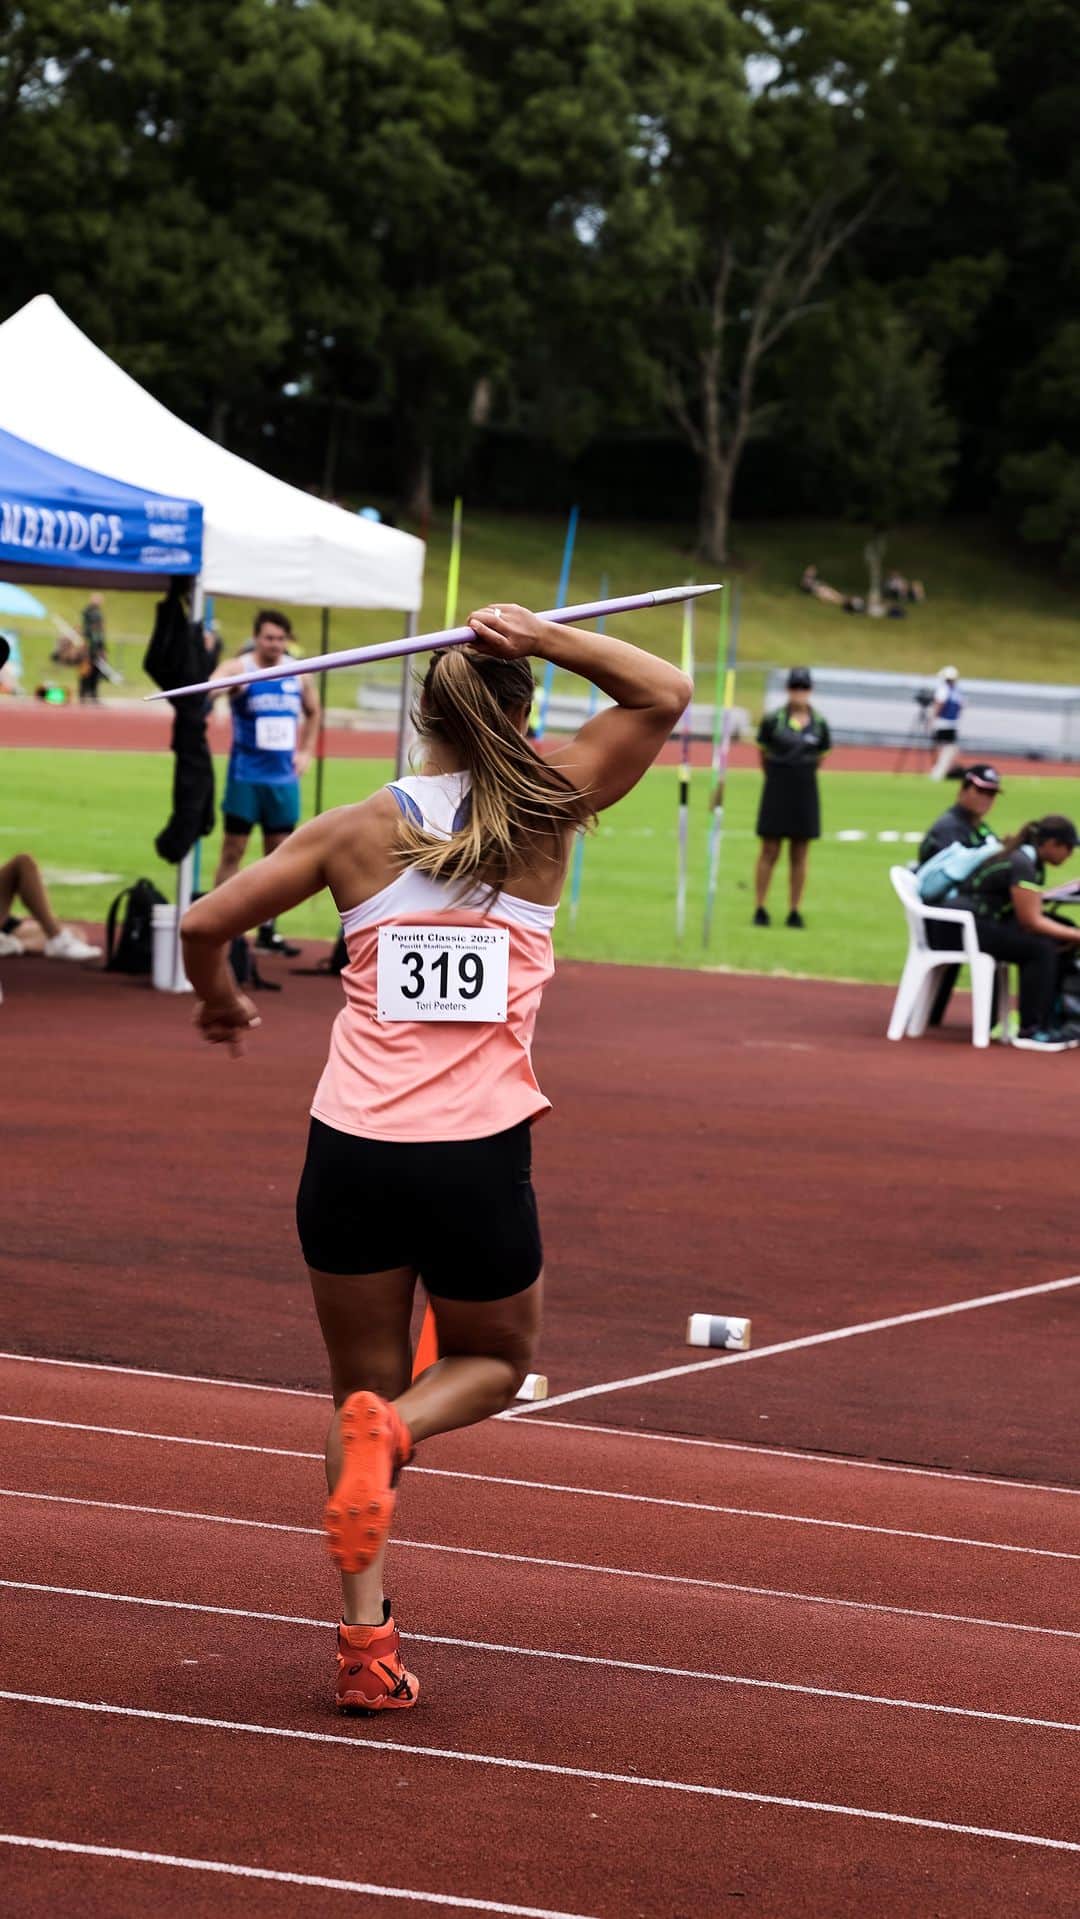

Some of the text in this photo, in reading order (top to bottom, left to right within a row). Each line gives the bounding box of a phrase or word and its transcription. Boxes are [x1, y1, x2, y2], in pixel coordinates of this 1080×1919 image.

[391, 933, 497, 944] Porritt Classic 2023
[400, 951, 484, 1000] 319
[416, 1001, 467, 1011] Tori Peeters
